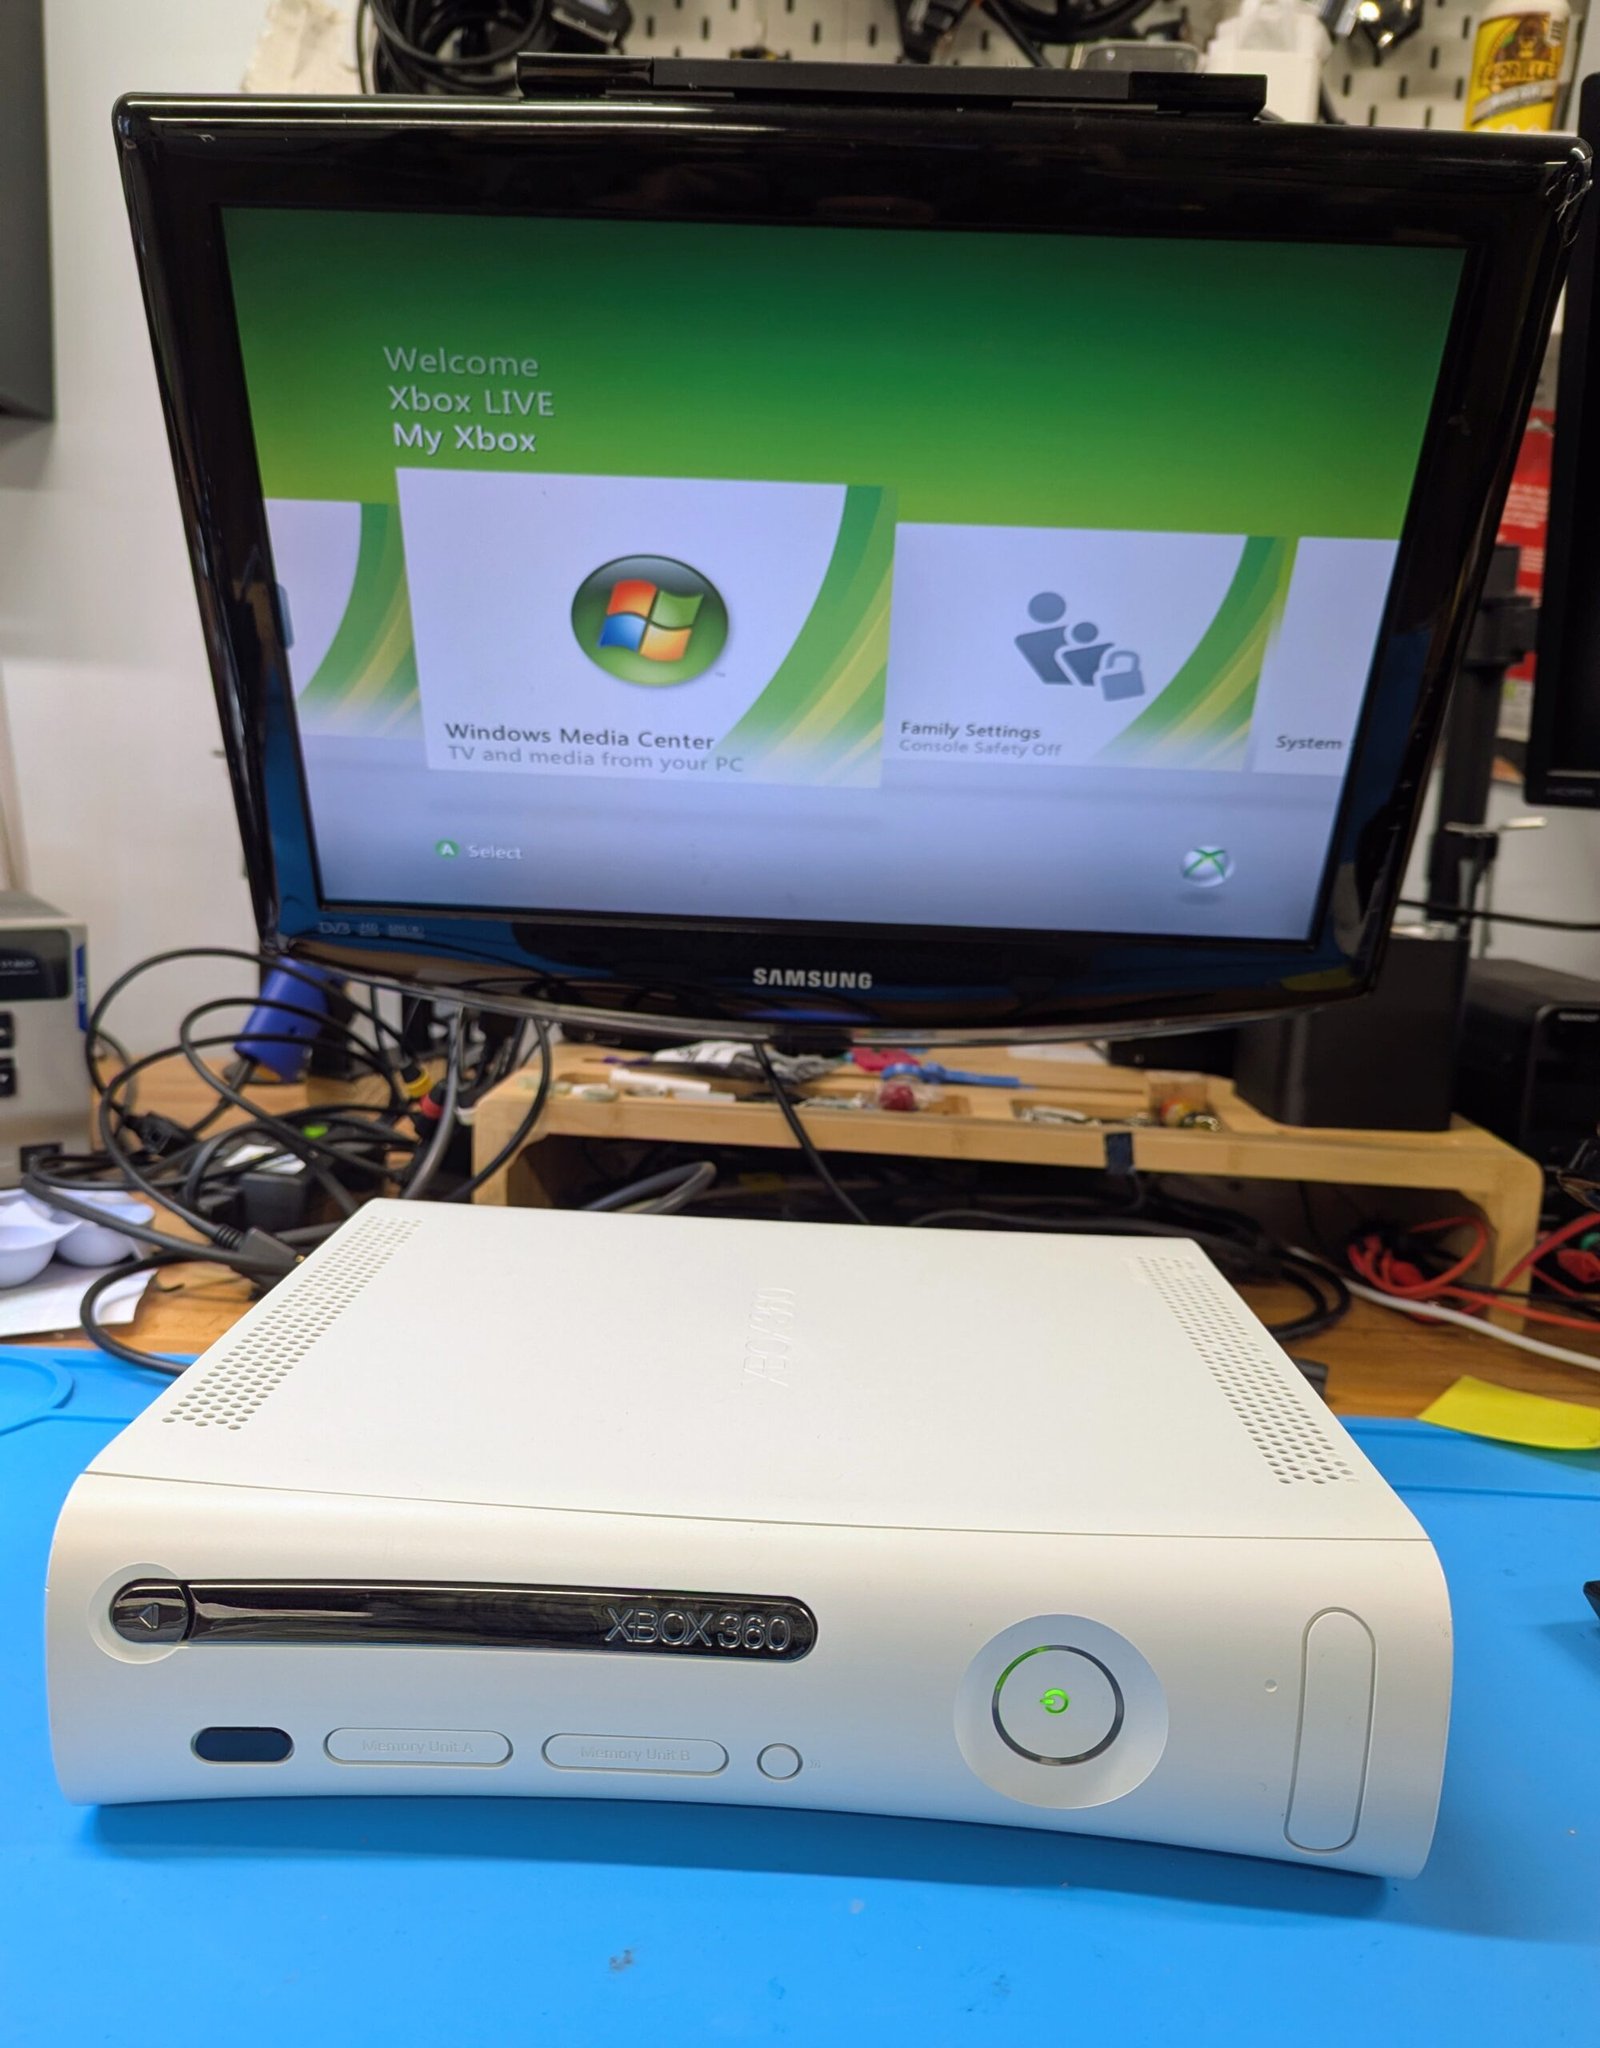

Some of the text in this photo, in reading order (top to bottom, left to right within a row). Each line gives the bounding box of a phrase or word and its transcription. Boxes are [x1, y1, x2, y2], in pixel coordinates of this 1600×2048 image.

[383, 346, 539, 377] Welcome
[388, 386, 554, 416] Xbox LIVE
[393, 422, 536, 455] My Xbox
[445, 723, 715, 750] Windows Media Center
[901, 722, 1041, 742] Family Settings
[1275, 735, 1342, 752] System
[448, 746, 744, 774] TV and media from your PC
[899, 739, 1063, 758] Console Safety Off
[468, 845, 523, 860] Select
[753, 967, 873, 990] SAMSUNG
[605, 1608, 791, 1651] XBOX 360
[362, 1740, 474, 1753] Memory Unit A
[581, 1746, 691, 1762] Memory Unit B
